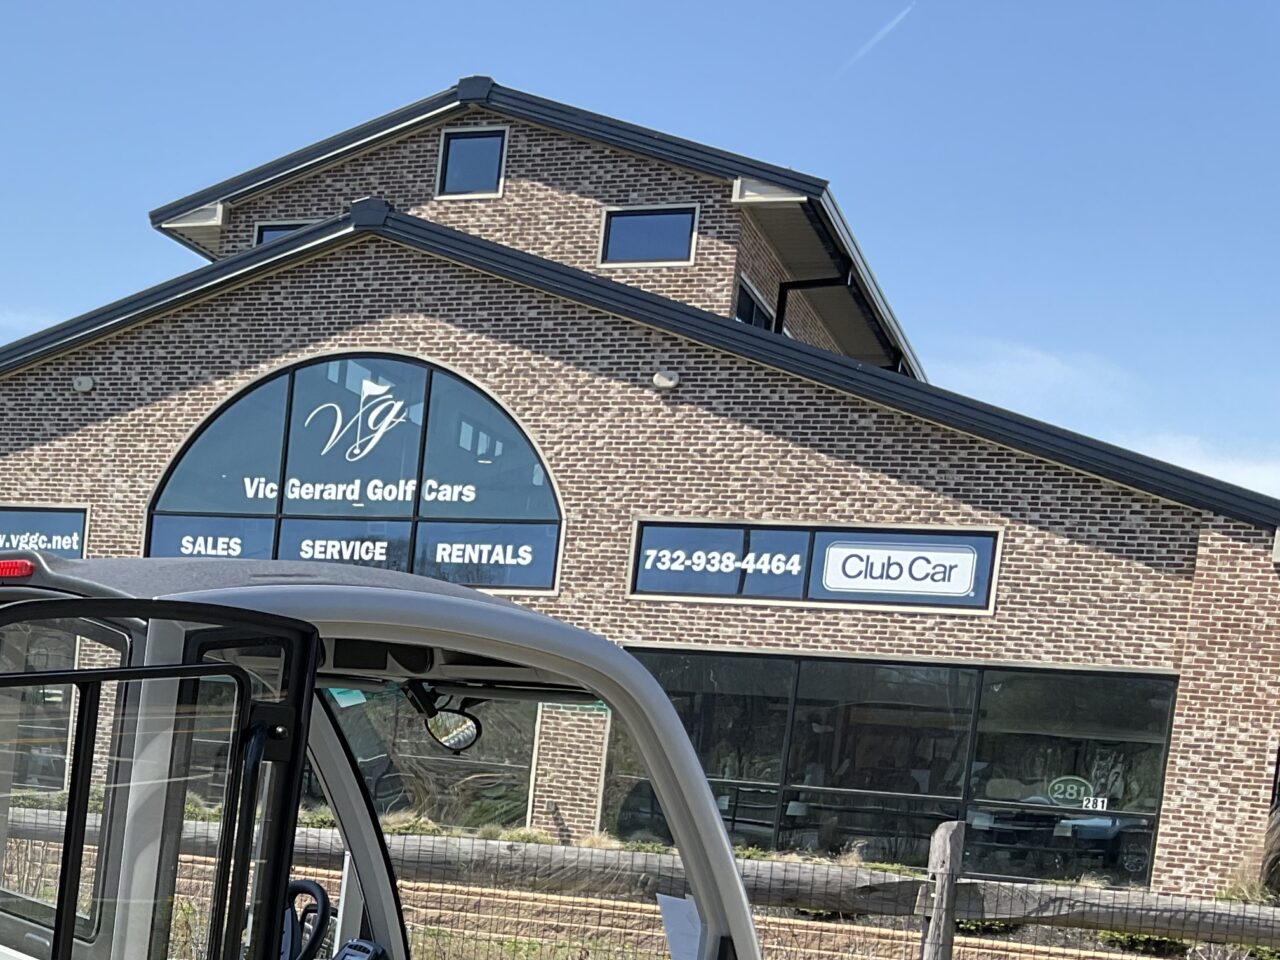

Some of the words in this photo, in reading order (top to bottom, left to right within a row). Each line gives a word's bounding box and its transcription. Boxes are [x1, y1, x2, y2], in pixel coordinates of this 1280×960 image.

[243, 477, 277, 499] Vic
[286, 478, 360, 502] Gerard
[366, 479, 416, 502] Golf
[424, 479, 476, 503] Cars
[180, 535, 242, 557] SALES
[300, 539, 388, 562] SERVICE
[435, 543, 533, 566] RENTALS
[644, 549, 801, 576] 732-938-4464
[841, 553, 903, 582] Club
[908, 556, 959, 583] Car
[1053, 784, 1085, 800] 281
[1084, 798, 1106, 809] 281
